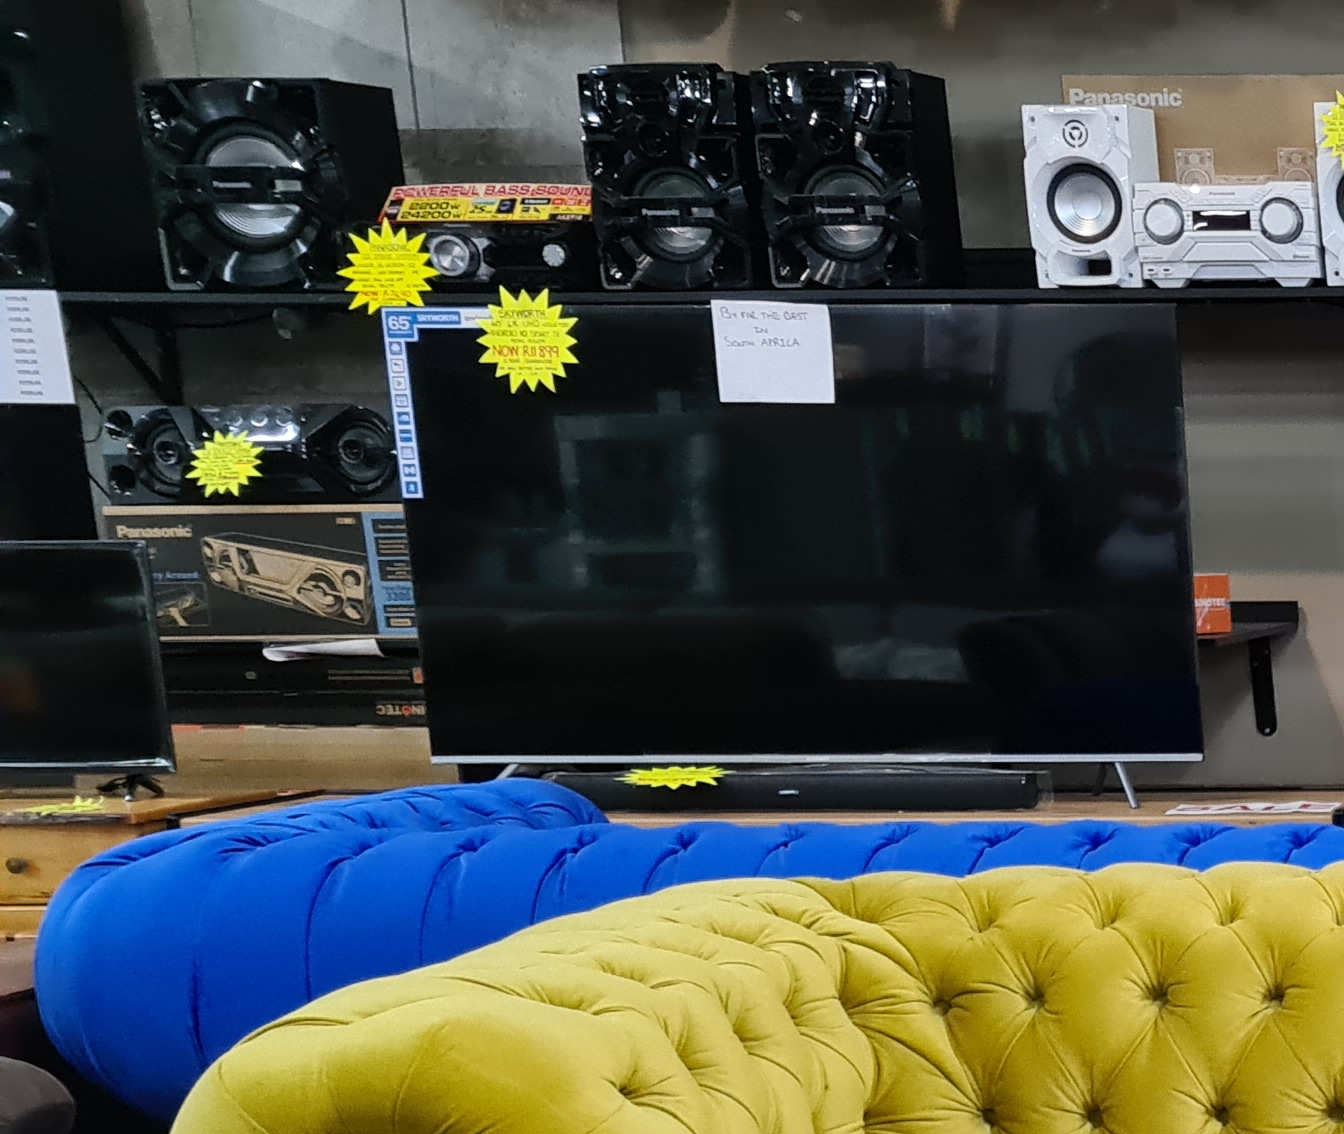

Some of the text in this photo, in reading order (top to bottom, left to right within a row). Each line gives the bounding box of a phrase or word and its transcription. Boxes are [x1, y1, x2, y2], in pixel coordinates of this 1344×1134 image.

[1069, 87, 1183, 107] Panasonic
[393, 185, 480, 199] POWERFUL
[484, 185, 530, 196] BASS
[492, 345, 519, 356] NOW
[116, 524, 193, 538] Panasonic
